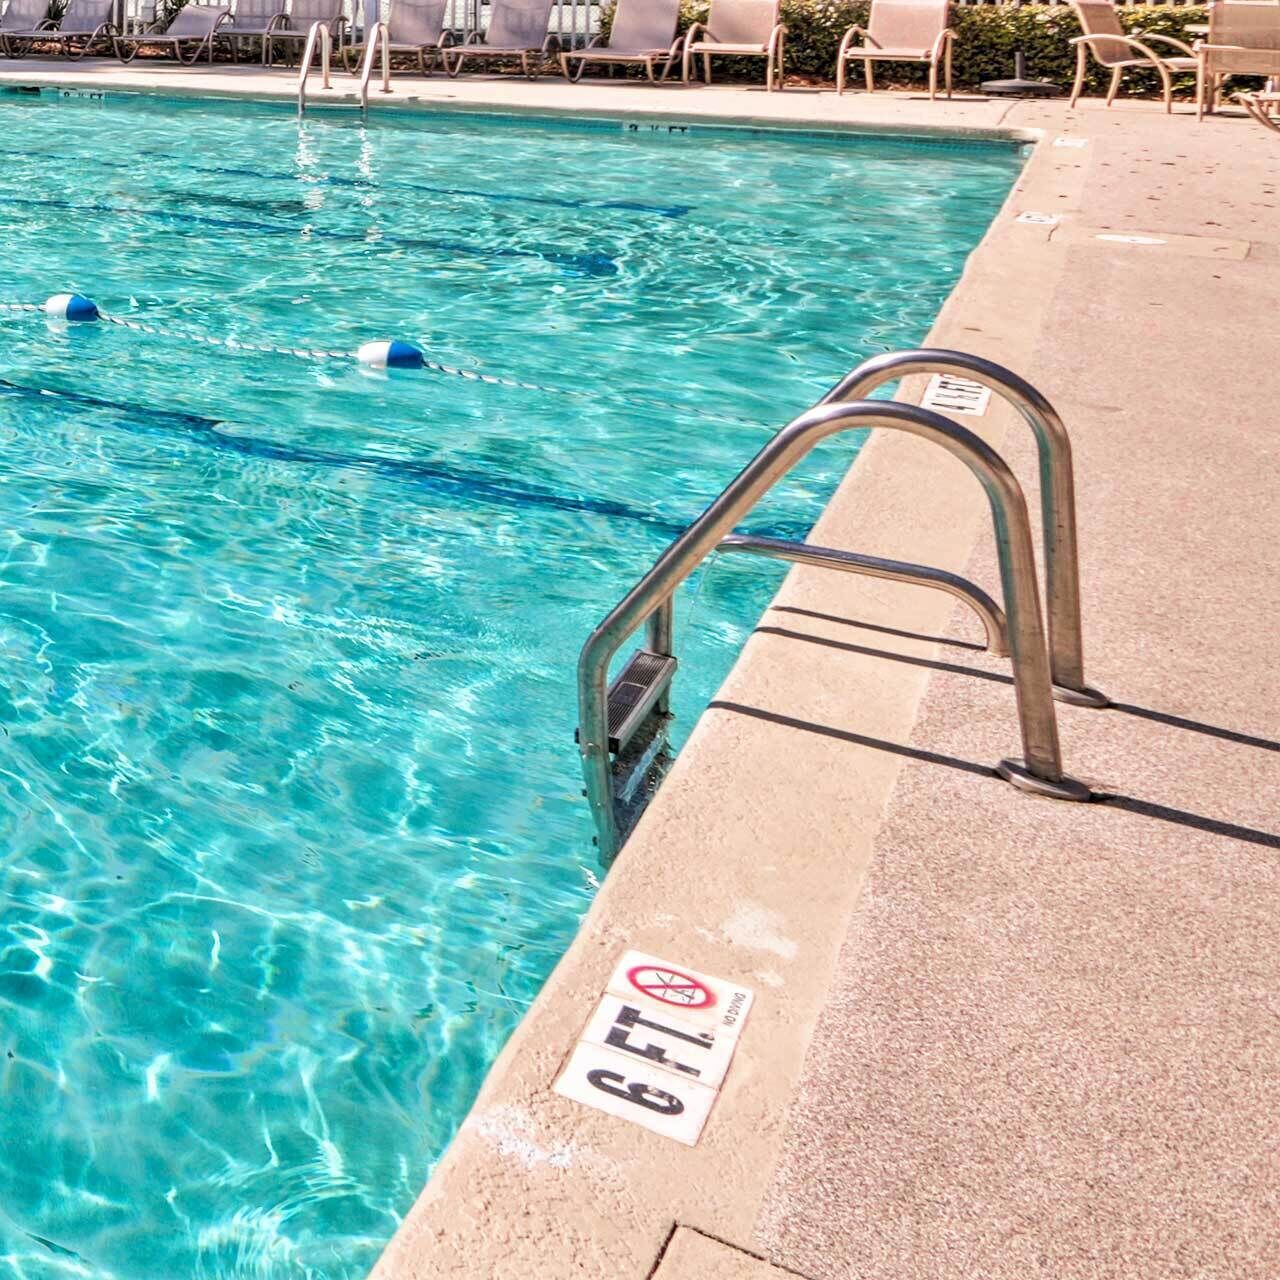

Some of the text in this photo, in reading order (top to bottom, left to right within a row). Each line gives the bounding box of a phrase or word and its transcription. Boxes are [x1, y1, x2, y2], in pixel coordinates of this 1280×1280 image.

[721, 992, 748, 1028] NO DIVING
[586, 1068, 685, 1116] 6
